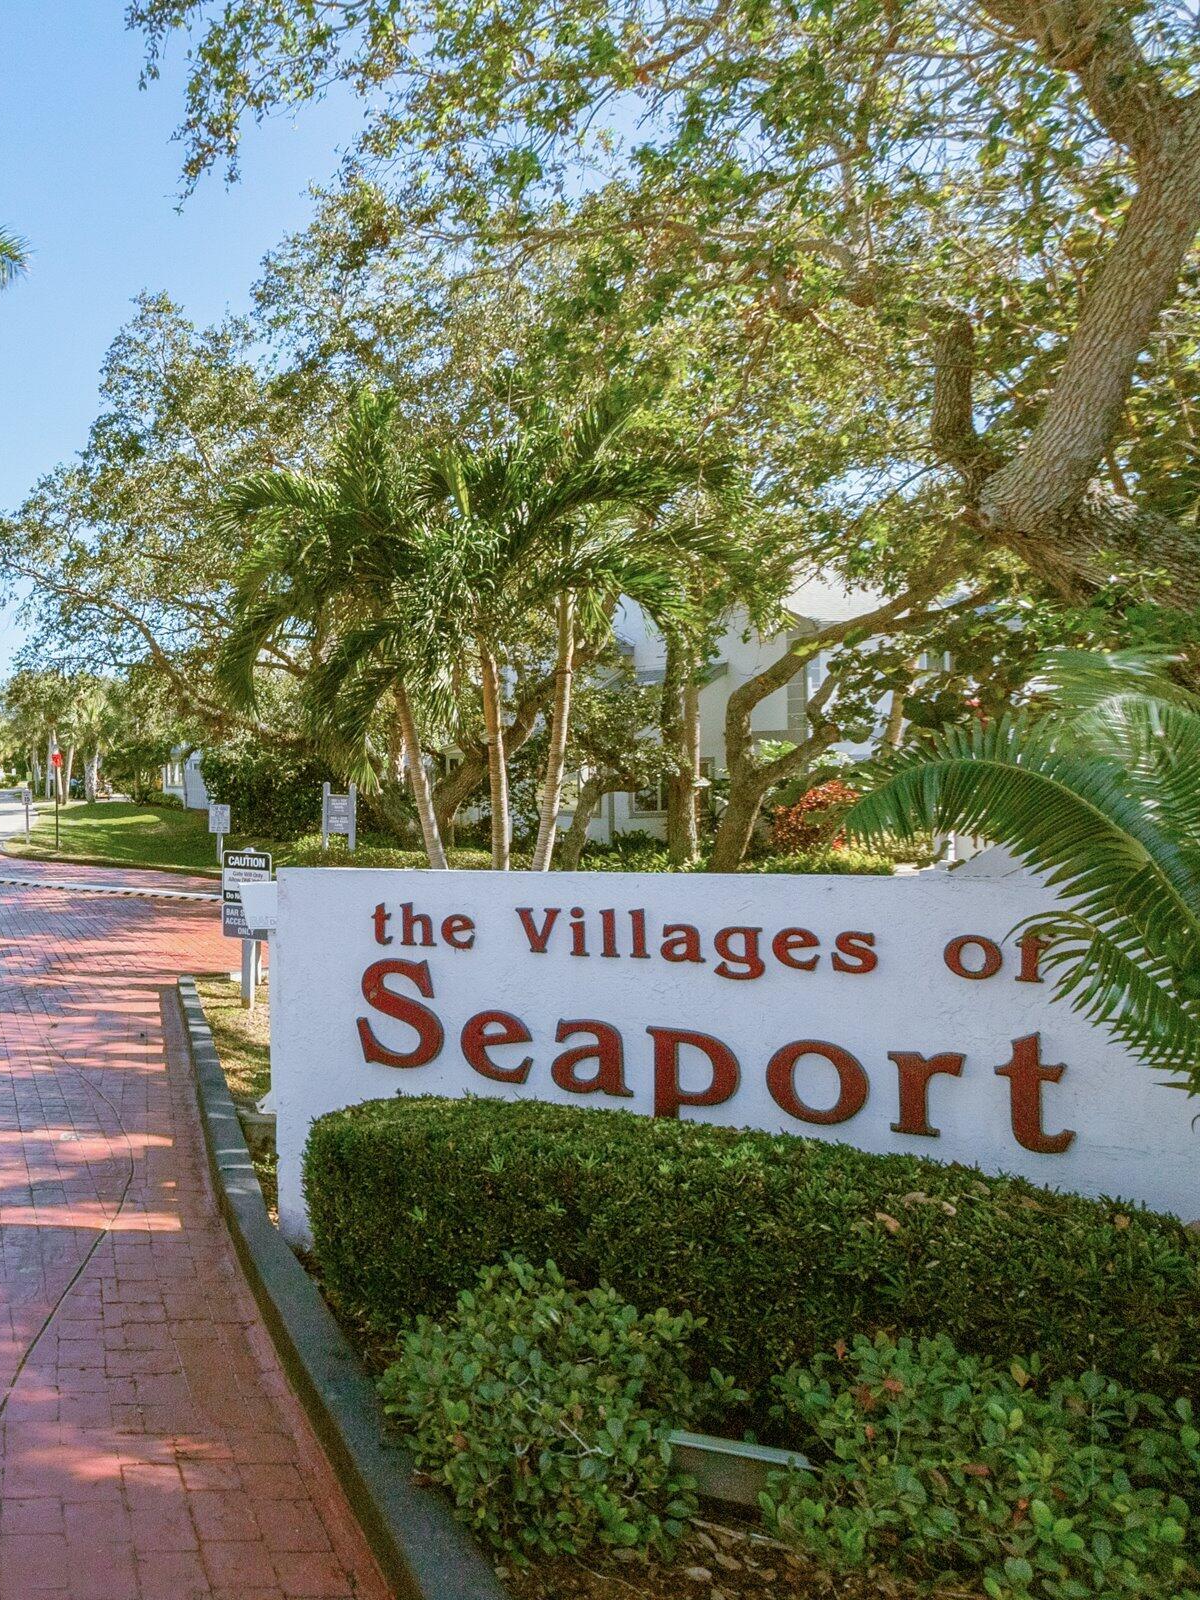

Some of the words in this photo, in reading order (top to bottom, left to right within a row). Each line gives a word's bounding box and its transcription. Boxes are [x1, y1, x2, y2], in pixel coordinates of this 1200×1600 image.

[228, 855, 266, 868] CAUTION
[225, 908, 239, 916] BAR
[225, 917, 247, 926] ACCES
[237, 926, 254, 936] ONLY
[370, 901, 476, 949] the
[515, 905, 879, 981] Villages
[943, 924, 1057, 984] of
[356, 958, 1078, 1158] Seaport
